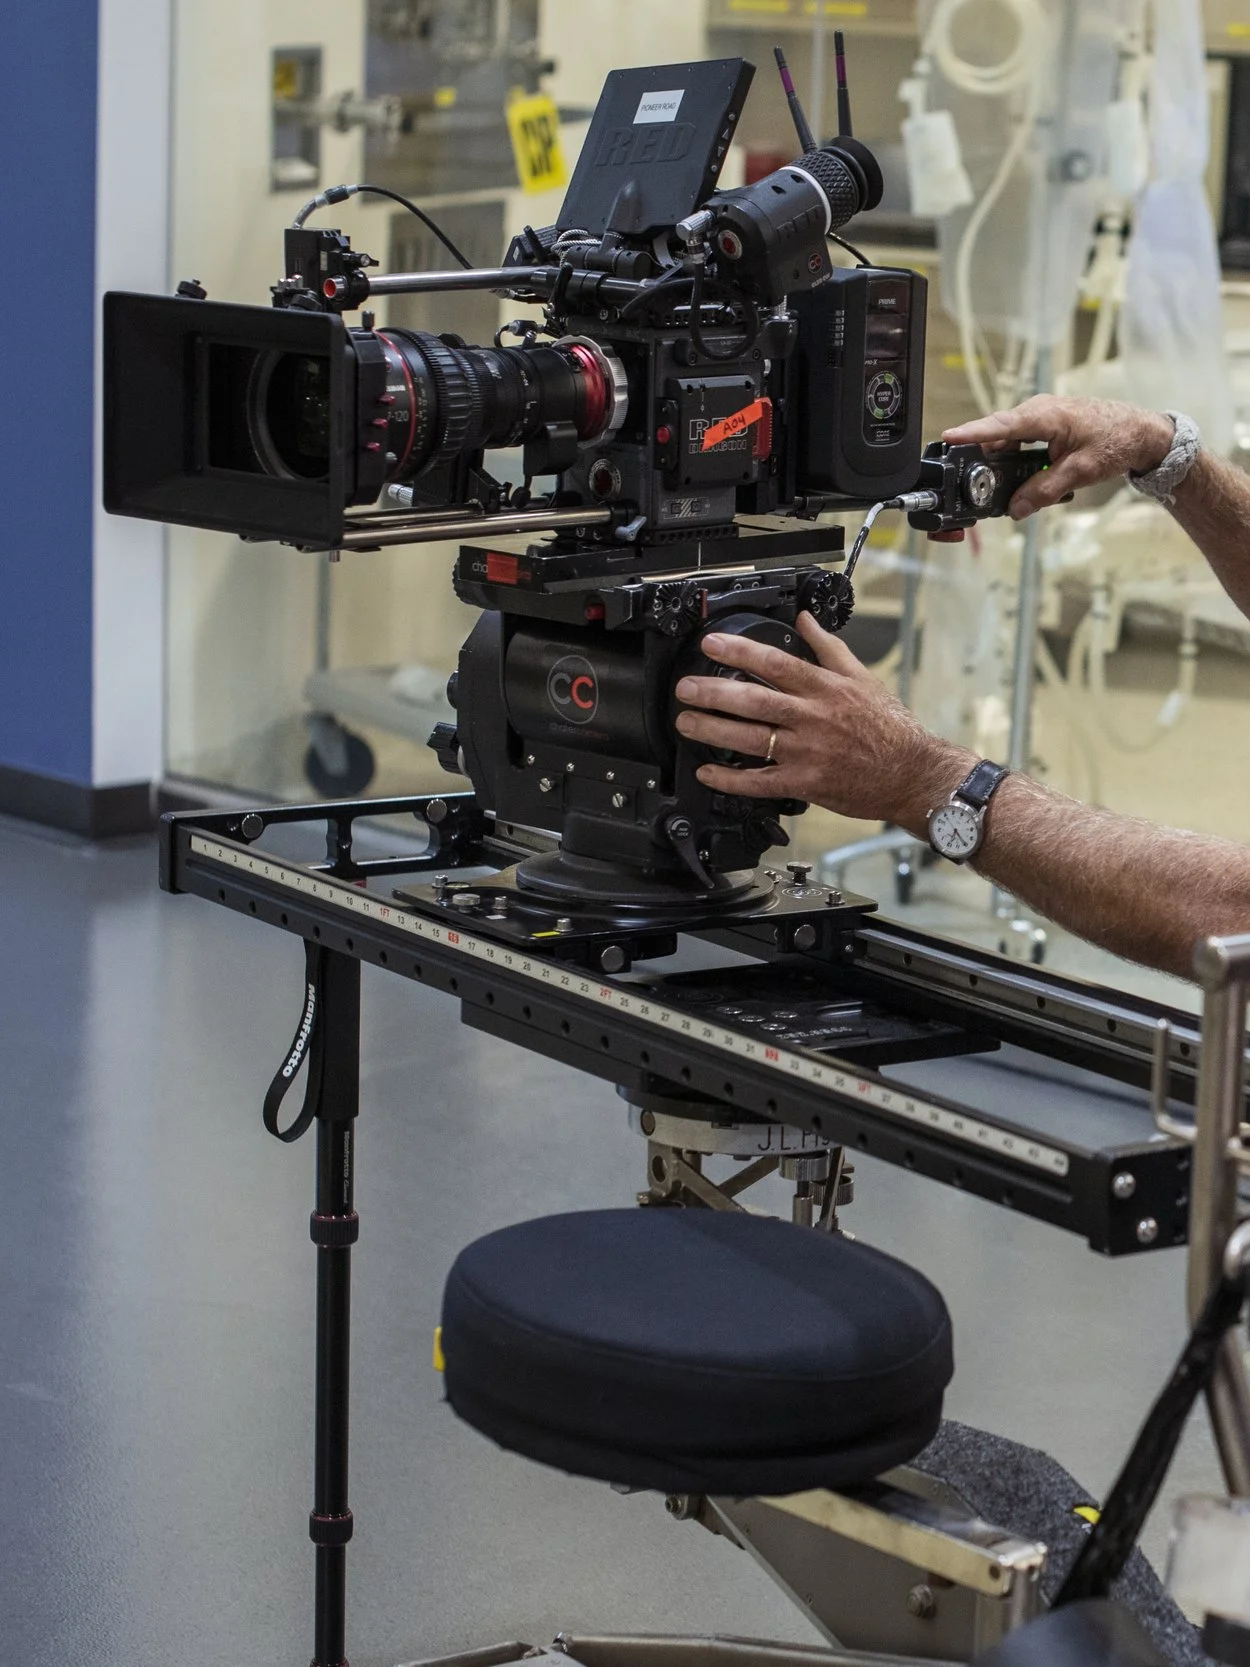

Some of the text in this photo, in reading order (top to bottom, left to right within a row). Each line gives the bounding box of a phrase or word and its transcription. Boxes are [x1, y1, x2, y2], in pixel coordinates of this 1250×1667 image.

[641, 102, 676, 112] PIONEER ROAD
[595, 123, 696, 166] RED
[723, 414, 746, 434] A04
[550, 672, 594, 709] CC
[346, 896, 353, 905] 10
[380, 907, 390, 917] 1FT
[398, 916, 405, 924] 13
[415, 922, 422, 930] 14
[432, 928, 440, 938] 15
[468, 942, 476, 950] 17
[486, 948, 494, 958] 18
[504, 955, 512, 964] 19
[523, 962, 531, 971] 20
[542, 968, 550, 978] 21
[561, 976, 569, 985] 22
[580, 982, 589, 992] 23
[600, 988, 612, 999] 2FT
[620, 997, 629, 1007] 25
[640, 1005, 649, 1015] 26
[661, 1012, 670, 1022] 27
[681, 1020, 690, 1030] 28
[282, 983, 315, 1078] Manfrotto
